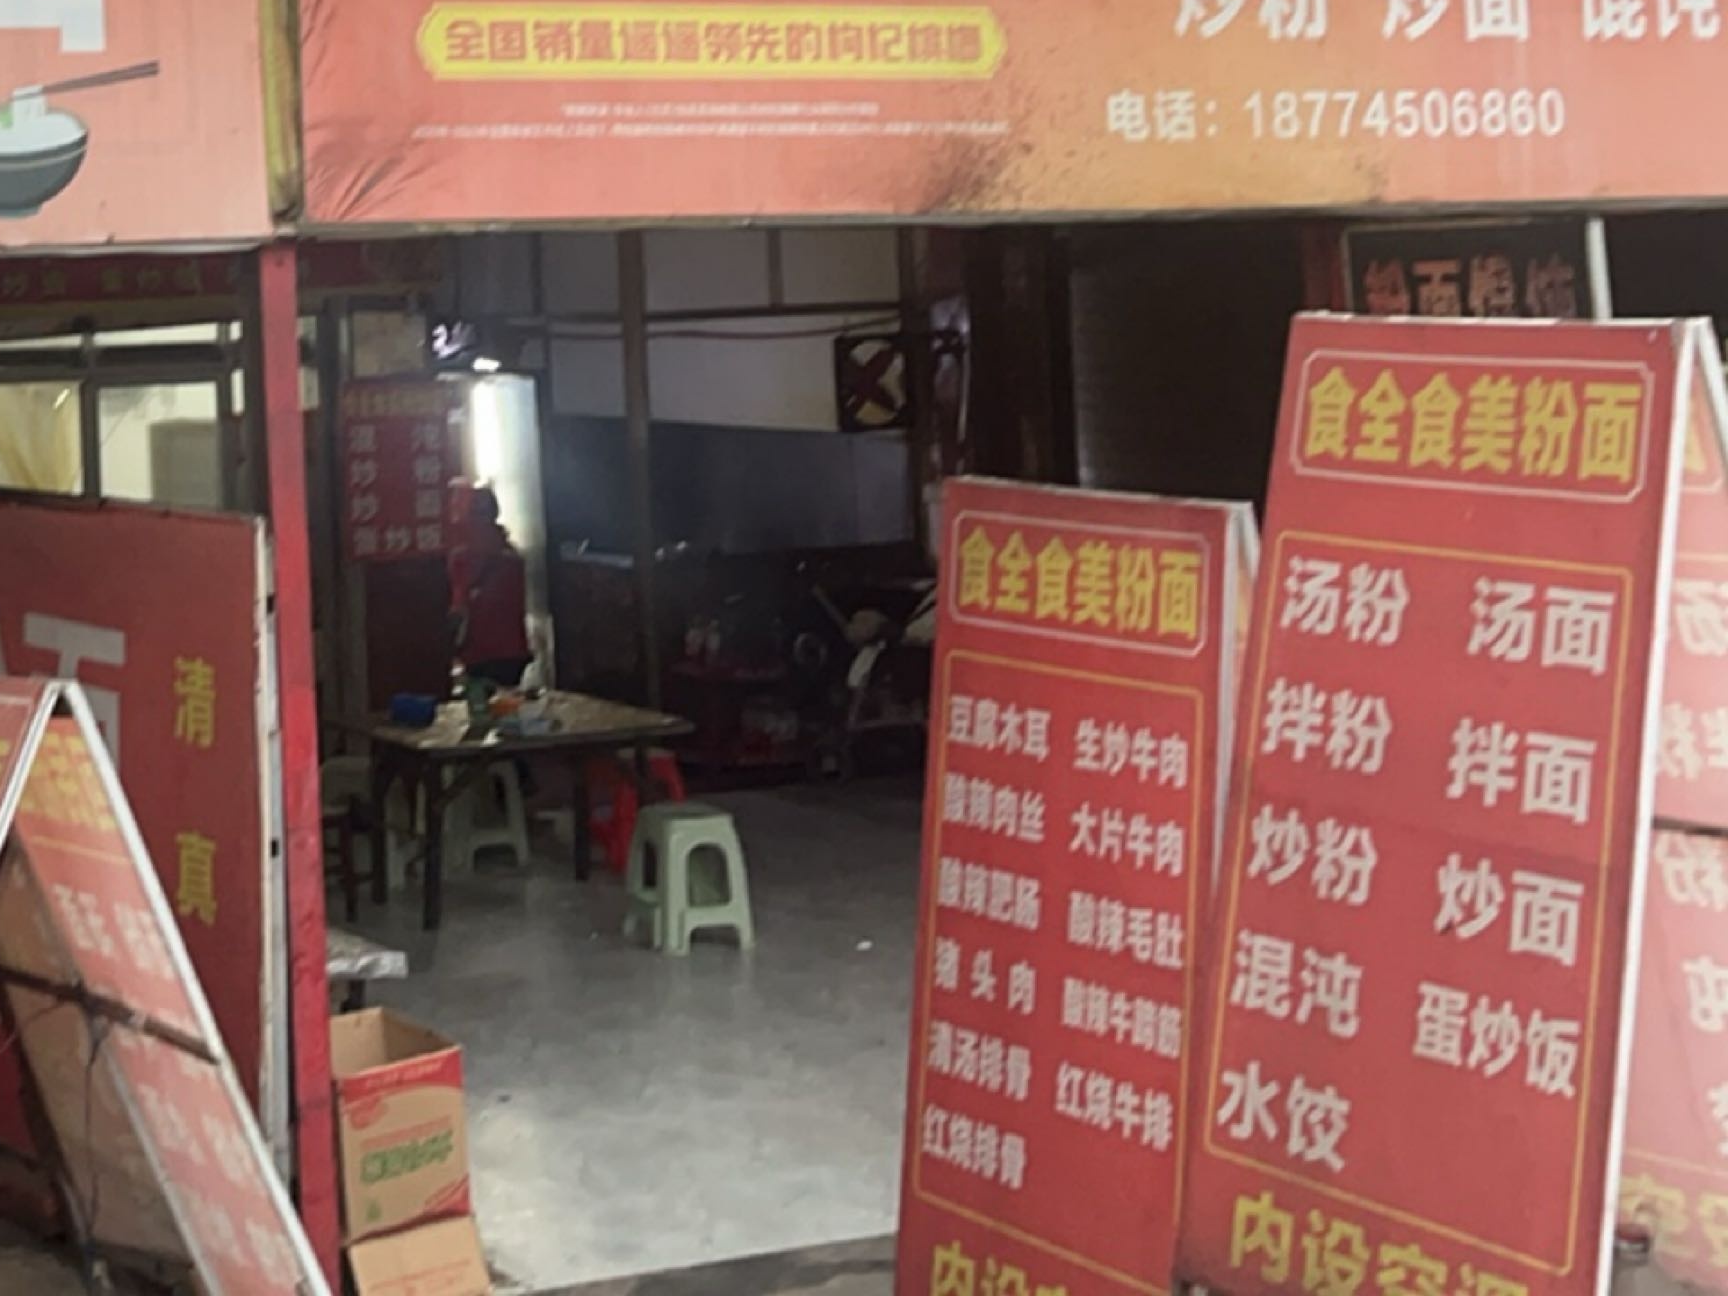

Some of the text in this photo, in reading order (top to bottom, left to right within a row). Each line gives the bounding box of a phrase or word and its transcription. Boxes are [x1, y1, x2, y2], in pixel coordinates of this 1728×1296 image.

[1303, 366, 1643, 483] 食全食美粉面
[959, 525, 1201, 640] 食全食美粉面
[1280, 555, 1410, 646] 汤粉
[1466, 576, 1616, 675] 汤面
[1074, 718, 1189, 788] 生炒牛肉
[1262, 677, 1392, 775] 拌粉
[1446, 718, 1597, 823] 拌面
[1070, 801, 1184, 876] 大片牛肉
[1247, 804, 1378, 905] 炒粉
[1434, 853, 1585, 967] 炒面
[1230, 929, 1363, 1038] 混沌
[1413, 981, 1579, 1099] 蛋炒饭
[1056, 1061, 1173, 1151] 红烧牛排
[1217, 1060, 1351, 1172] 水饺
